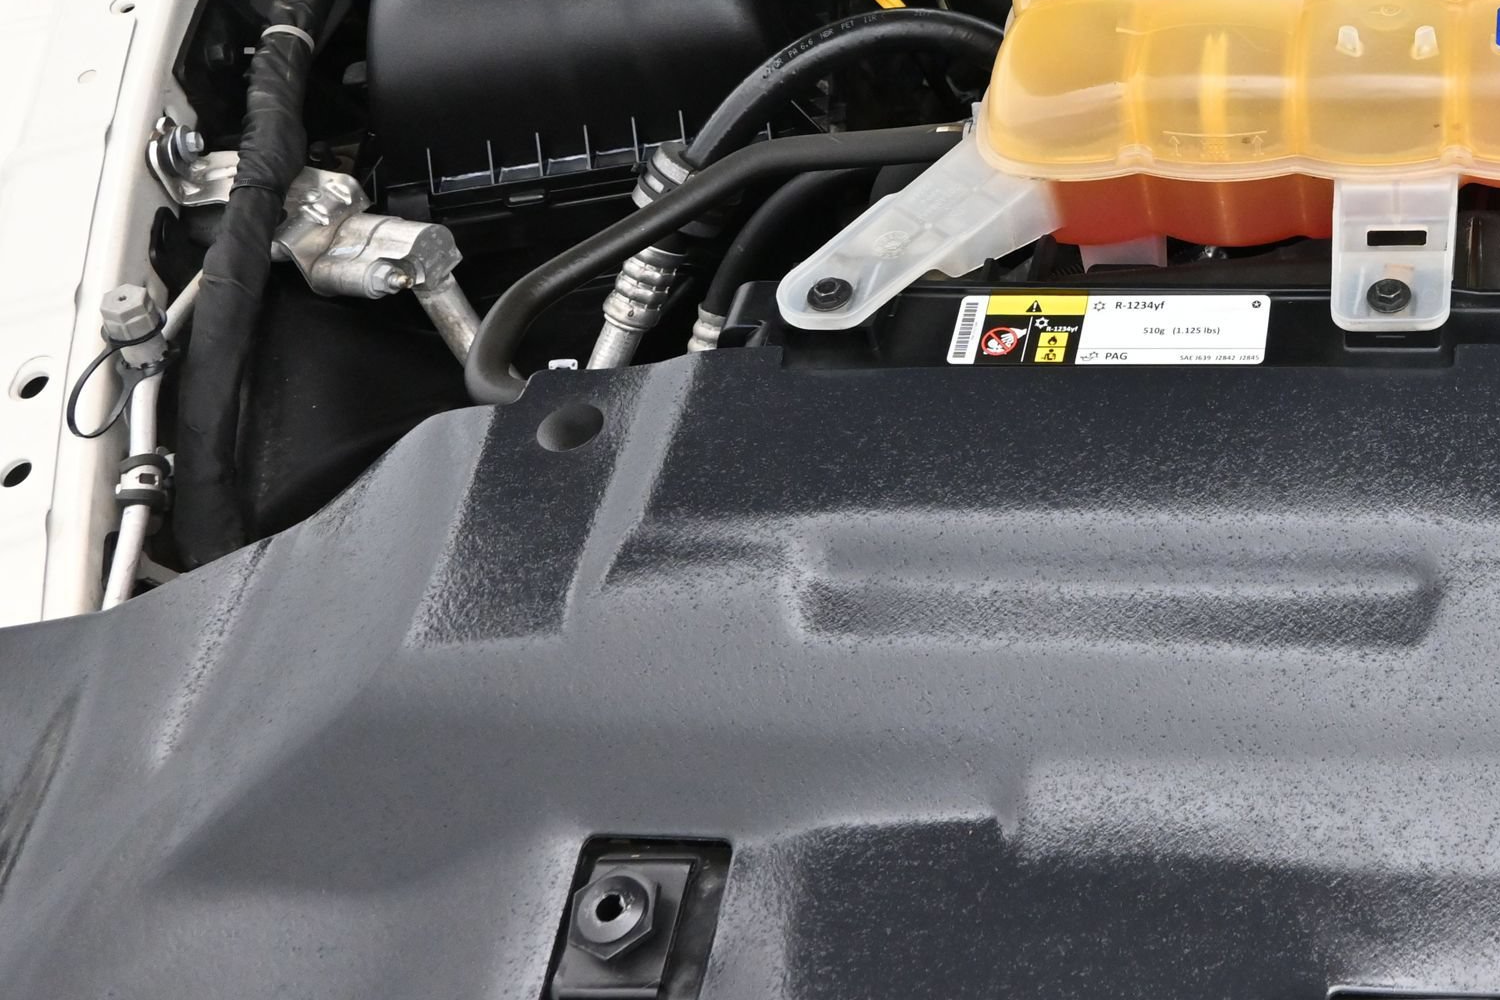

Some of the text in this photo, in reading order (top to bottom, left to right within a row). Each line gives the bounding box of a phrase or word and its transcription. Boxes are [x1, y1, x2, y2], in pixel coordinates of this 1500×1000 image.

[1115, 301, 1166, 311] R-1234yf
[1045, 325, 1079, 333] R-1234yf
[1143, 326, 1221, 336] 510g (1.125 lbs)
[1105, 352, 1128, 361] PAG
